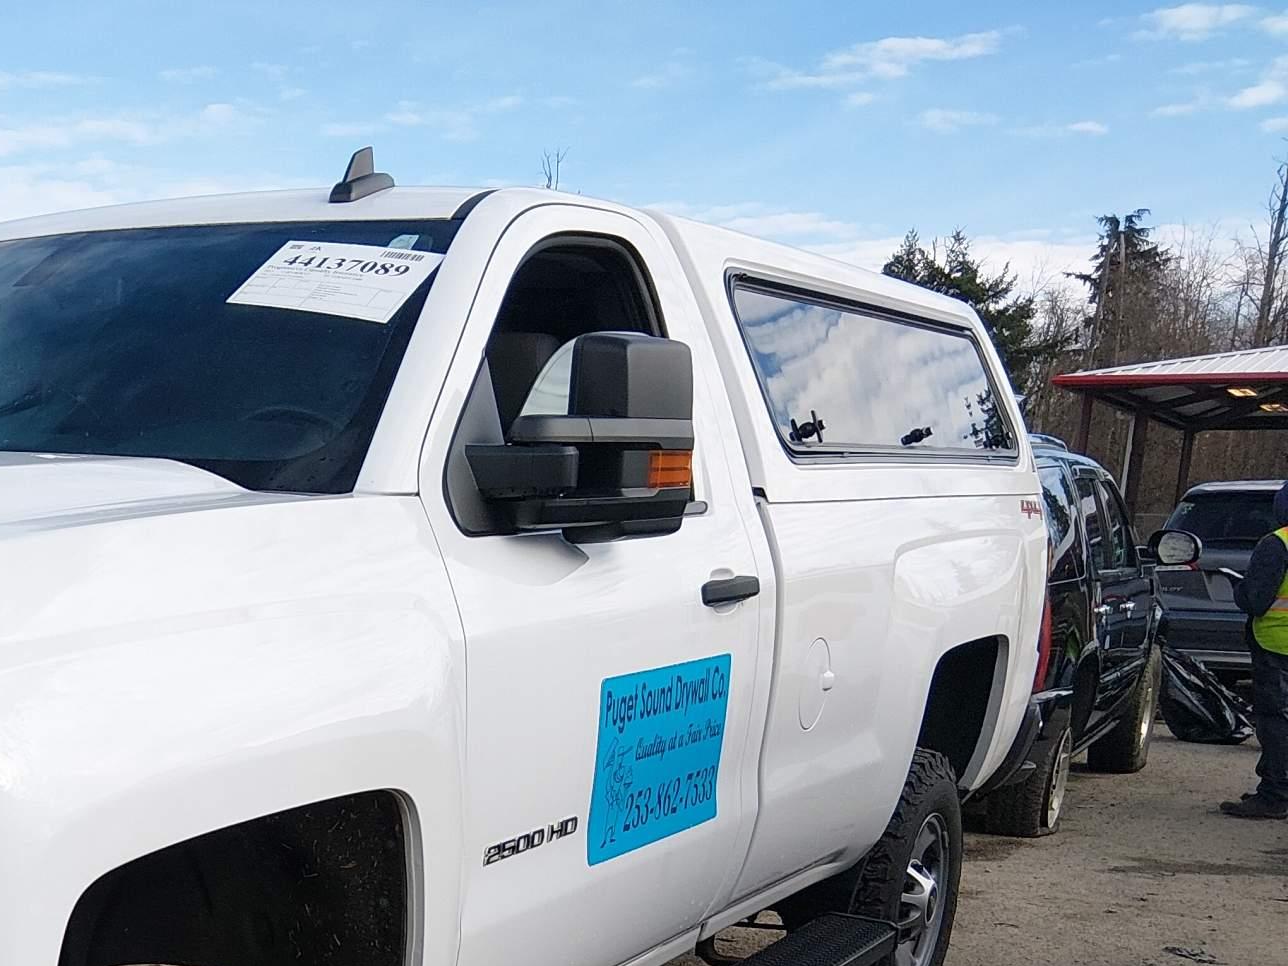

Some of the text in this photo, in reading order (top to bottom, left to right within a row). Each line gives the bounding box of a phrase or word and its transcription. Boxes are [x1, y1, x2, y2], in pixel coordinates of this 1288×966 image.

[283, 254, 410, 277] 44137089
[604, 665, 726, 733] Puget Sound Drywall Co.
[635, 718, 721, 760] Quality at a Fair Price
[623, 765, 715, 832] 253-862-7533
[483, 816, 578, 867] 2500 HD
